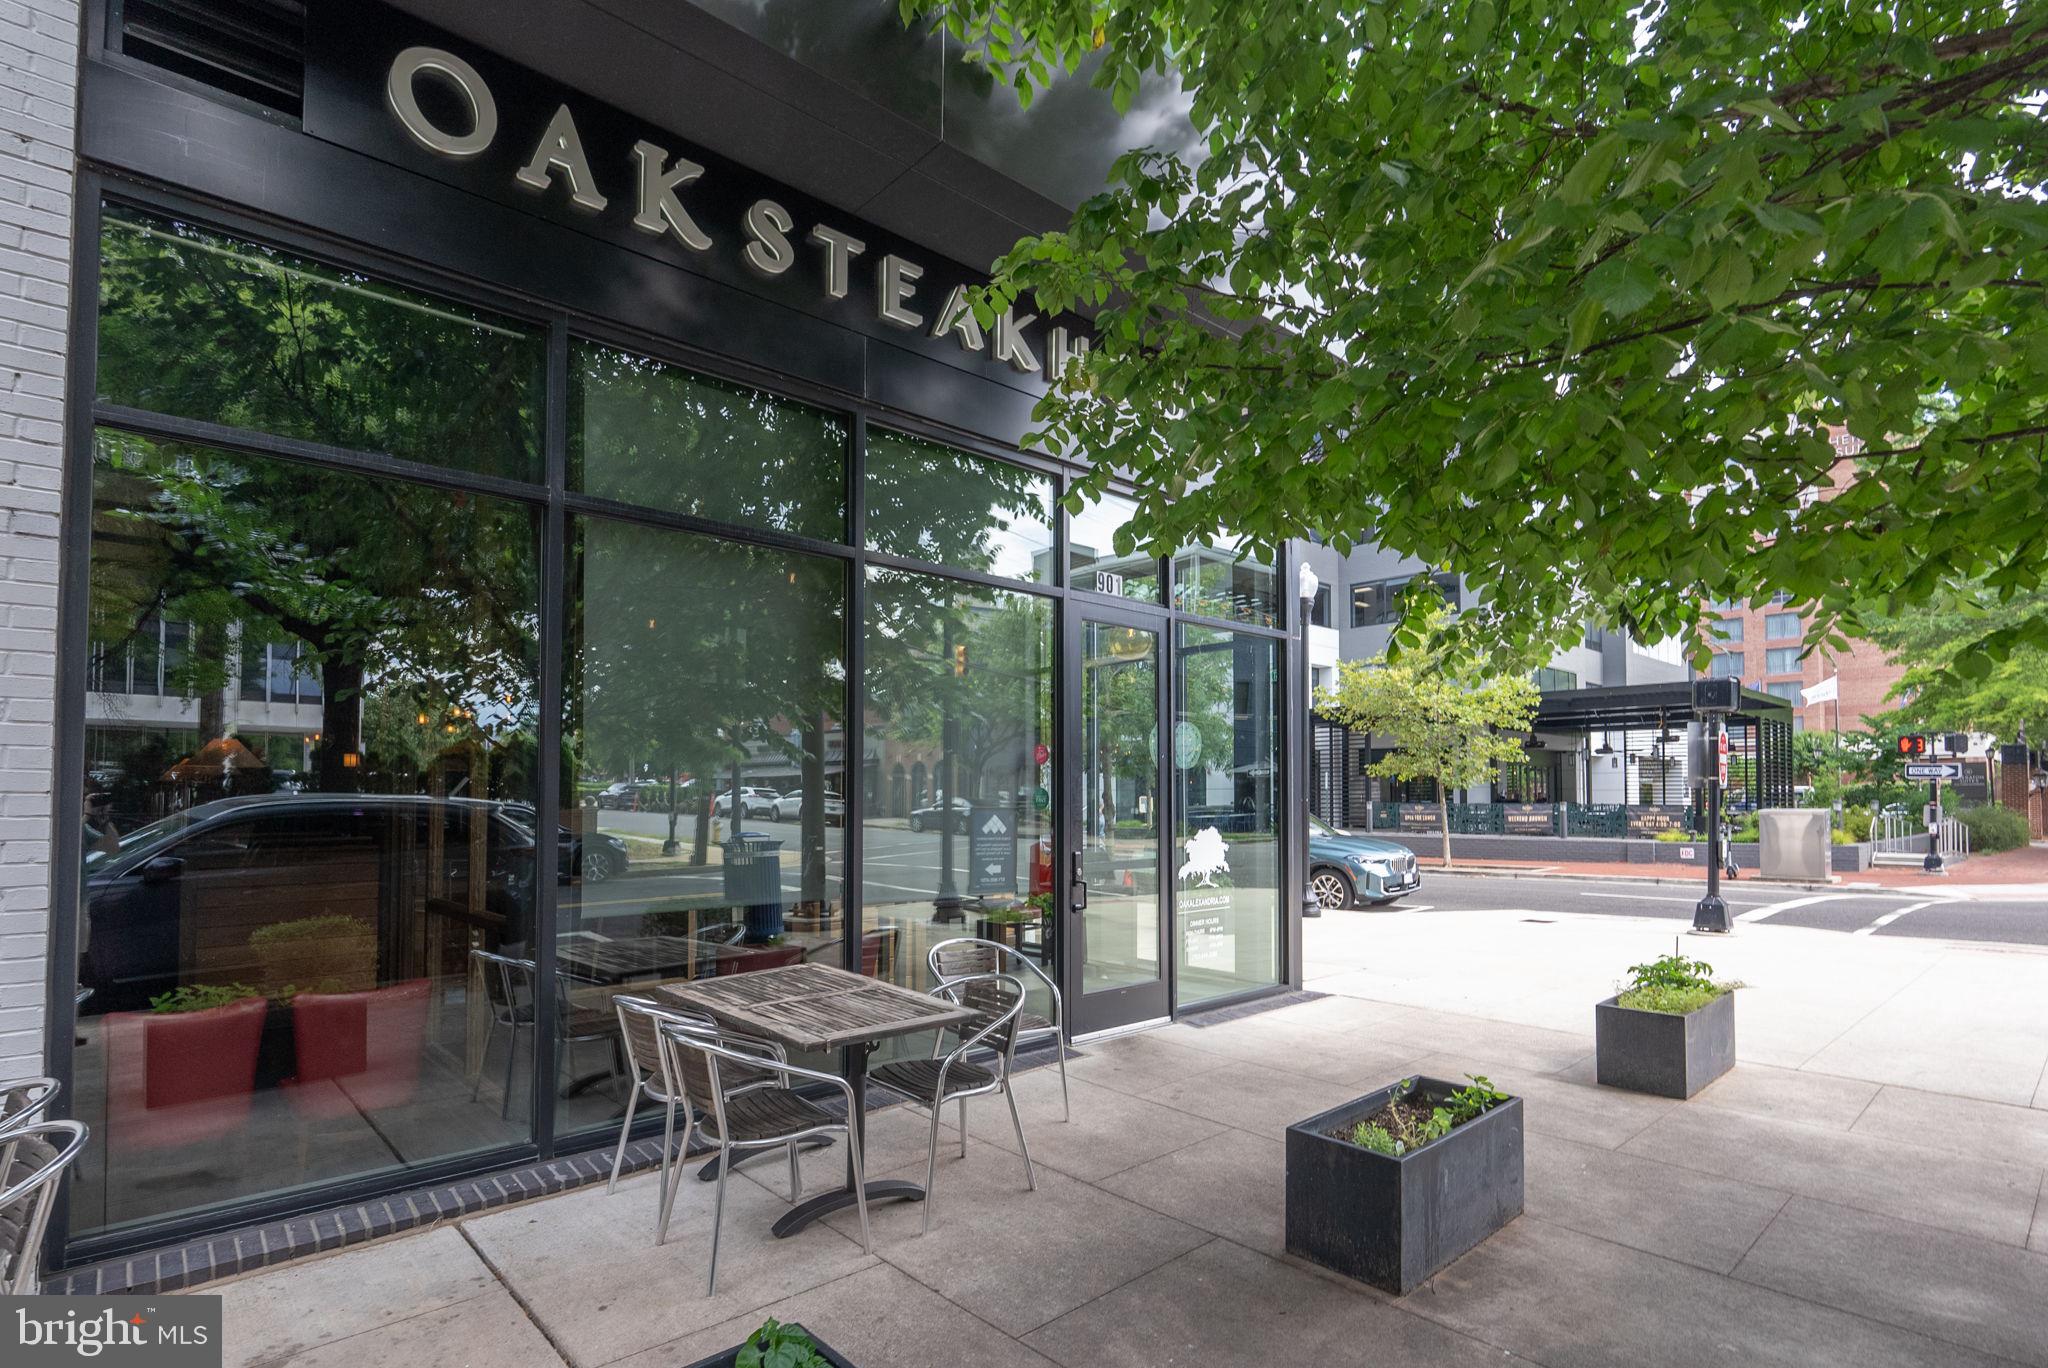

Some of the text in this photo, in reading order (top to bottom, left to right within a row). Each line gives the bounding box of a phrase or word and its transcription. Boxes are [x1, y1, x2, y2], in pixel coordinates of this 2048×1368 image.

[387, 45, 713, 251] OAK
[1097, 572, 1121, 596] 901
[1916, 738, 1923, 752] 3
[1911, 767, 1942, 775] ONE WAY
[1507, 815, 1528, 823] WEEKEND
[1179, 896, 1230, 908] OAKALEXANDRIA.COM
